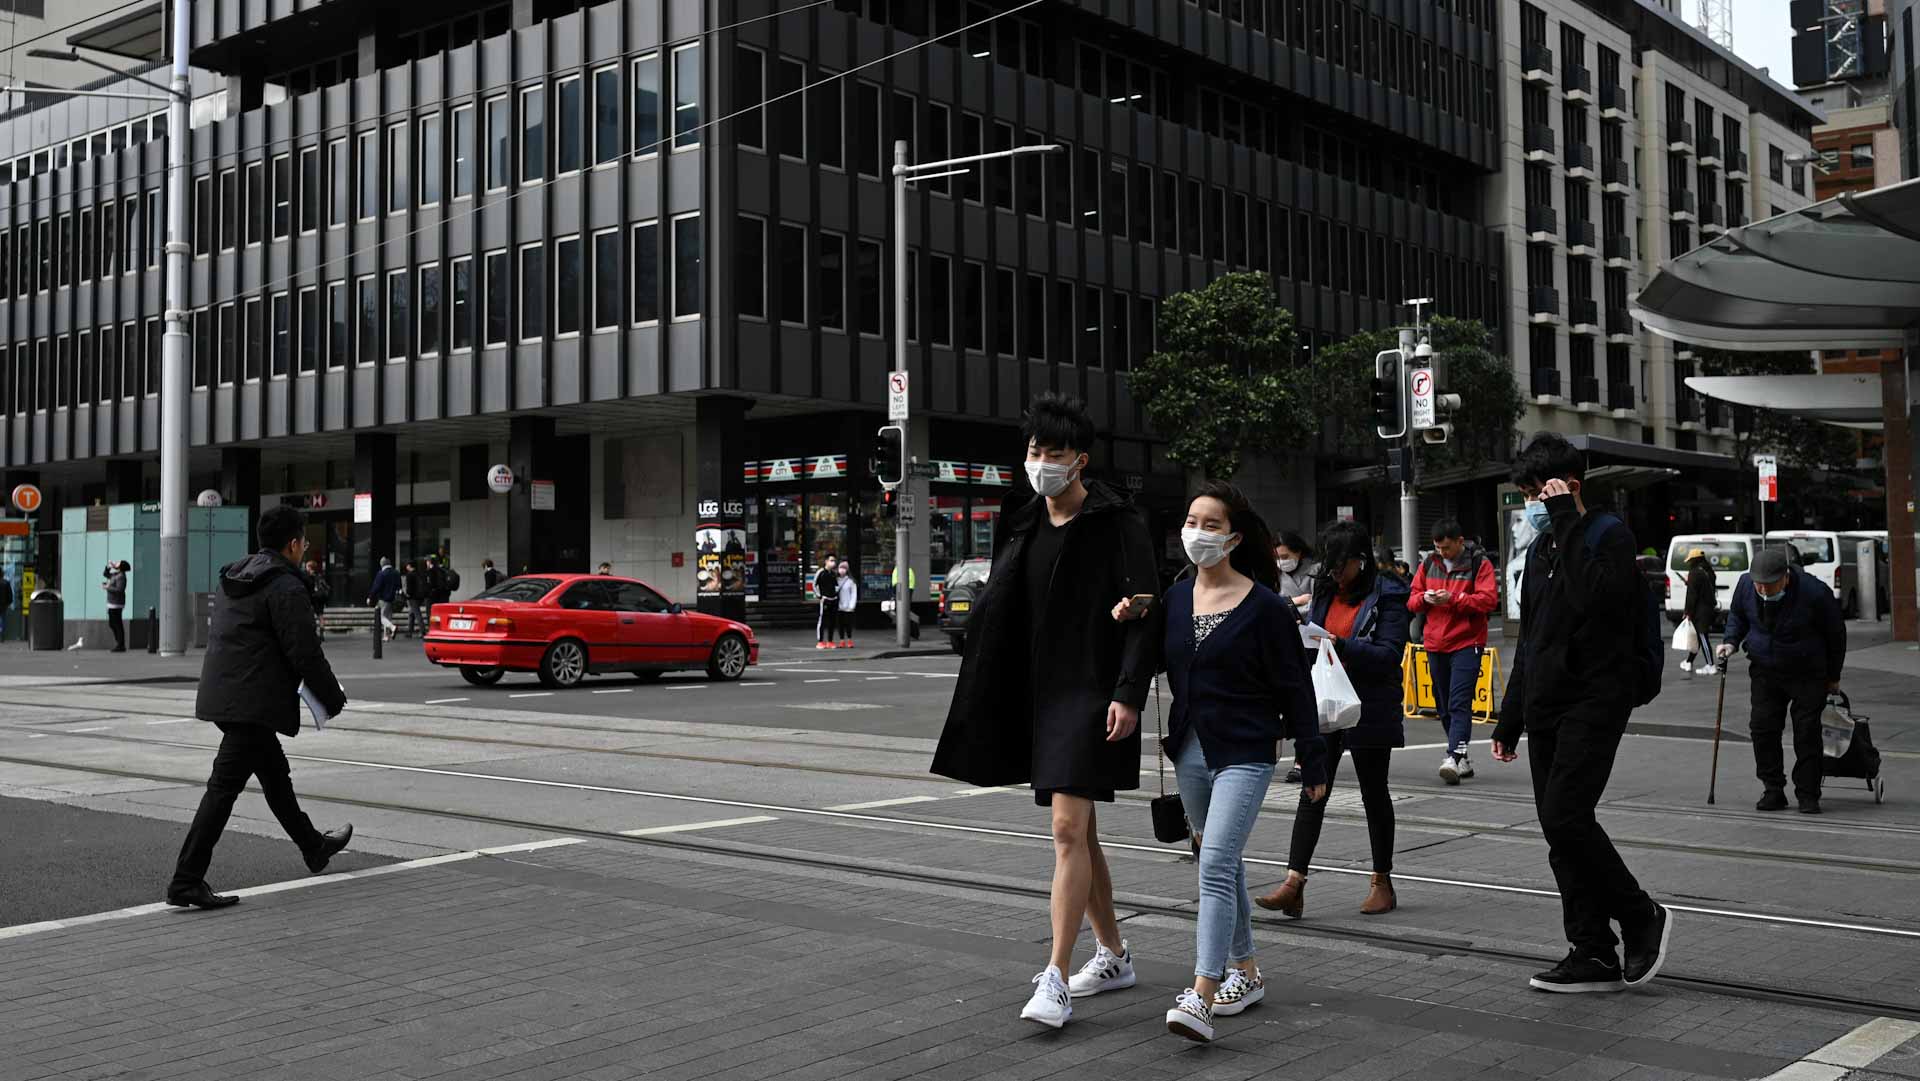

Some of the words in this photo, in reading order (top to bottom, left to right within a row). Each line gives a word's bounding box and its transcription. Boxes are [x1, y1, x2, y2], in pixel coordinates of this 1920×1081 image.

[893, 395, 904, 403] NO
[1416, 399, 1428, 408] NO
[775, 468, 788, 476] CITY
[819, 465, 832, 473] CITY
[494, 475, 512, 484] CITY
[23, 491, 34, 506] T
[141, 503, 157, 512] George
[699, 502, 719, 514] UGG
[723, 502, 743, 514] UGG
